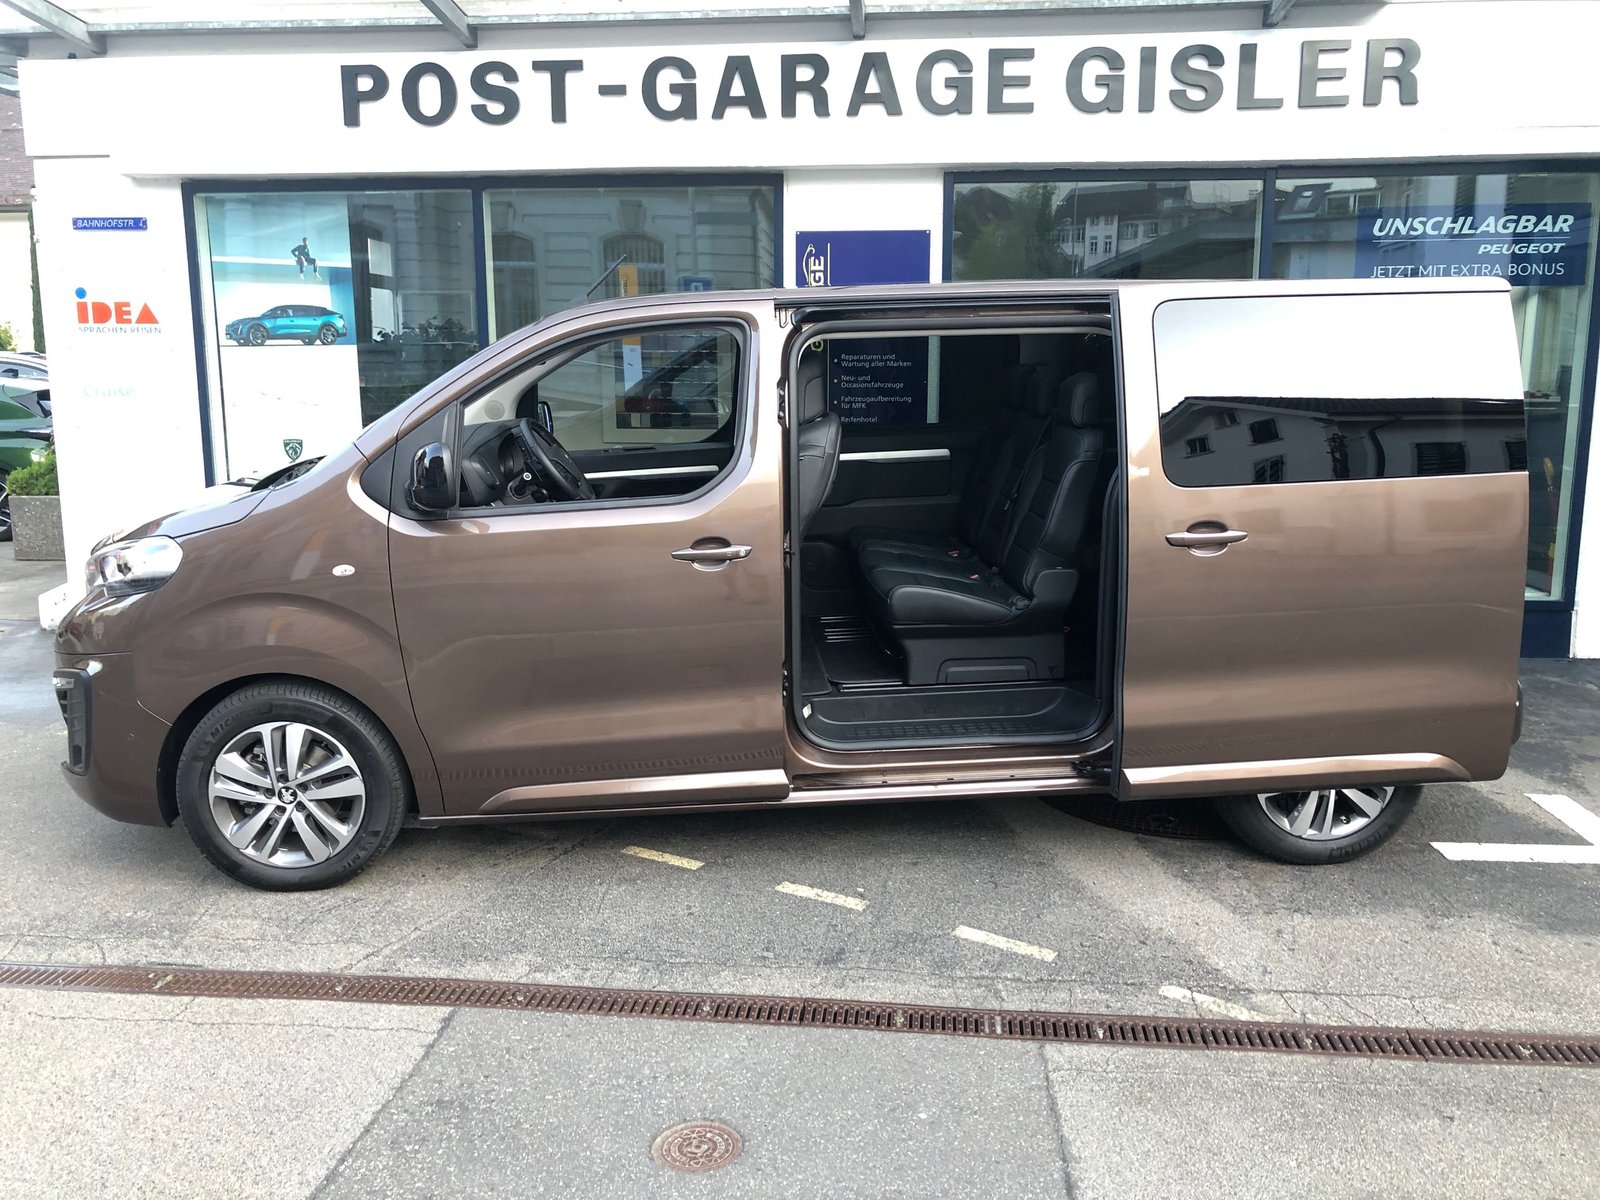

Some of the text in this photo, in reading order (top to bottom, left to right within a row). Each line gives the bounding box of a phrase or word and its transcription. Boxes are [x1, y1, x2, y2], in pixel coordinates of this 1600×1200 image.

[340, 38, 1422, 127] POST-GARAGE GISLER
[1372, 214, 1575, 237] UNSCHLAGBAR
[1477, 243, 1566, 255] PEUGEOT
[1370, 262, 1565, 278] JETZT MIT EXTRA BONUS
[78, 326, 127, 334] SPRACHEN
